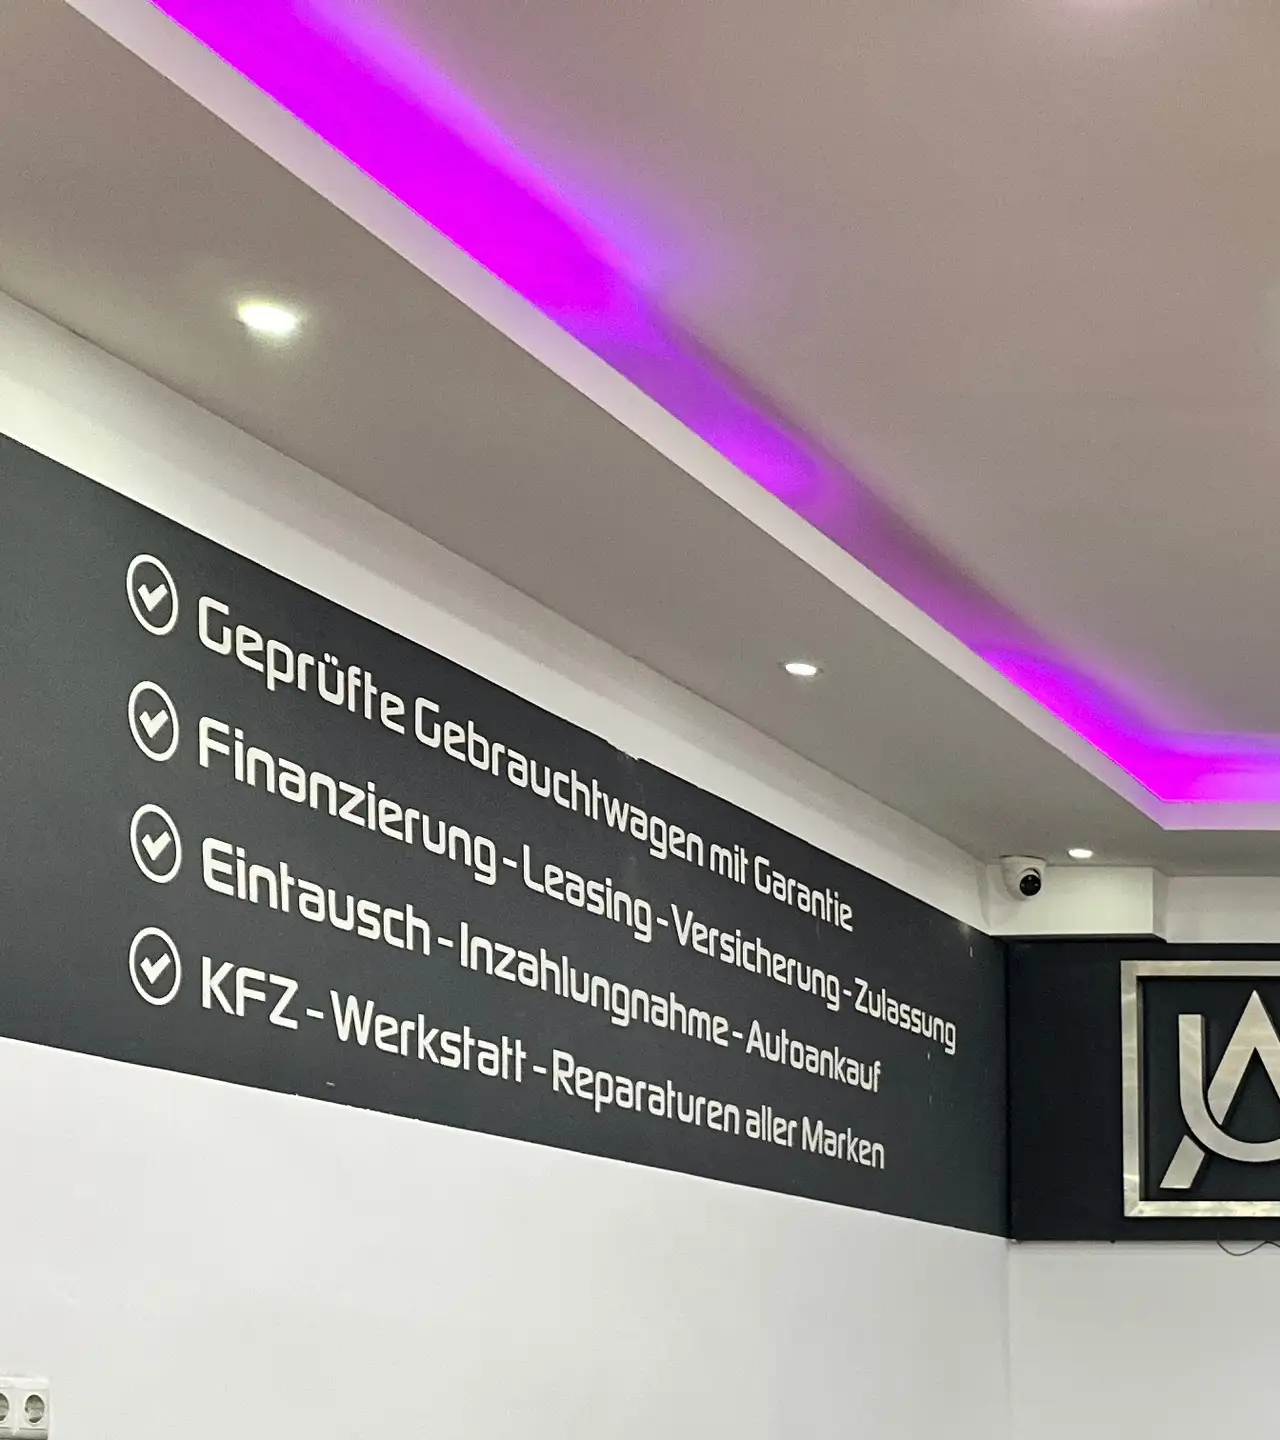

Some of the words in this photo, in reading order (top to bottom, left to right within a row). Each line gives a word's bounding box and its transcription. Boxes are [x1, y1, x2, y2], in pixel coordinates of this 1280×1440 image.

[198, 595, 405, 735] Geprüfte
[415, 696, 704, 867] Gebrauchtwagen
[710, 844, 749, 884] mit
[754, 855, 854, 932] Garantie
[198, 716, 497, 886] Finanzierung
[522, 844, 652, 943] Leasing
[670, 903, 840, 1012] Versicherung
[854, 977, 956, 1055] Zulassung
[201, 837, 430, 956] Eintausch
[460, 921, 729, 1048] Inzahlungnahme
[746, 1019, 882, 1093] Autoankauf
[201, 956, 299, 1030] KFZ
[329, 989, 527, 1083] Werkstatt
[552, 1049, 740, 1135] Reparaturen
[745, 1105, 798, 1148] aller
[801, 1116, 885, 1170] Marken
